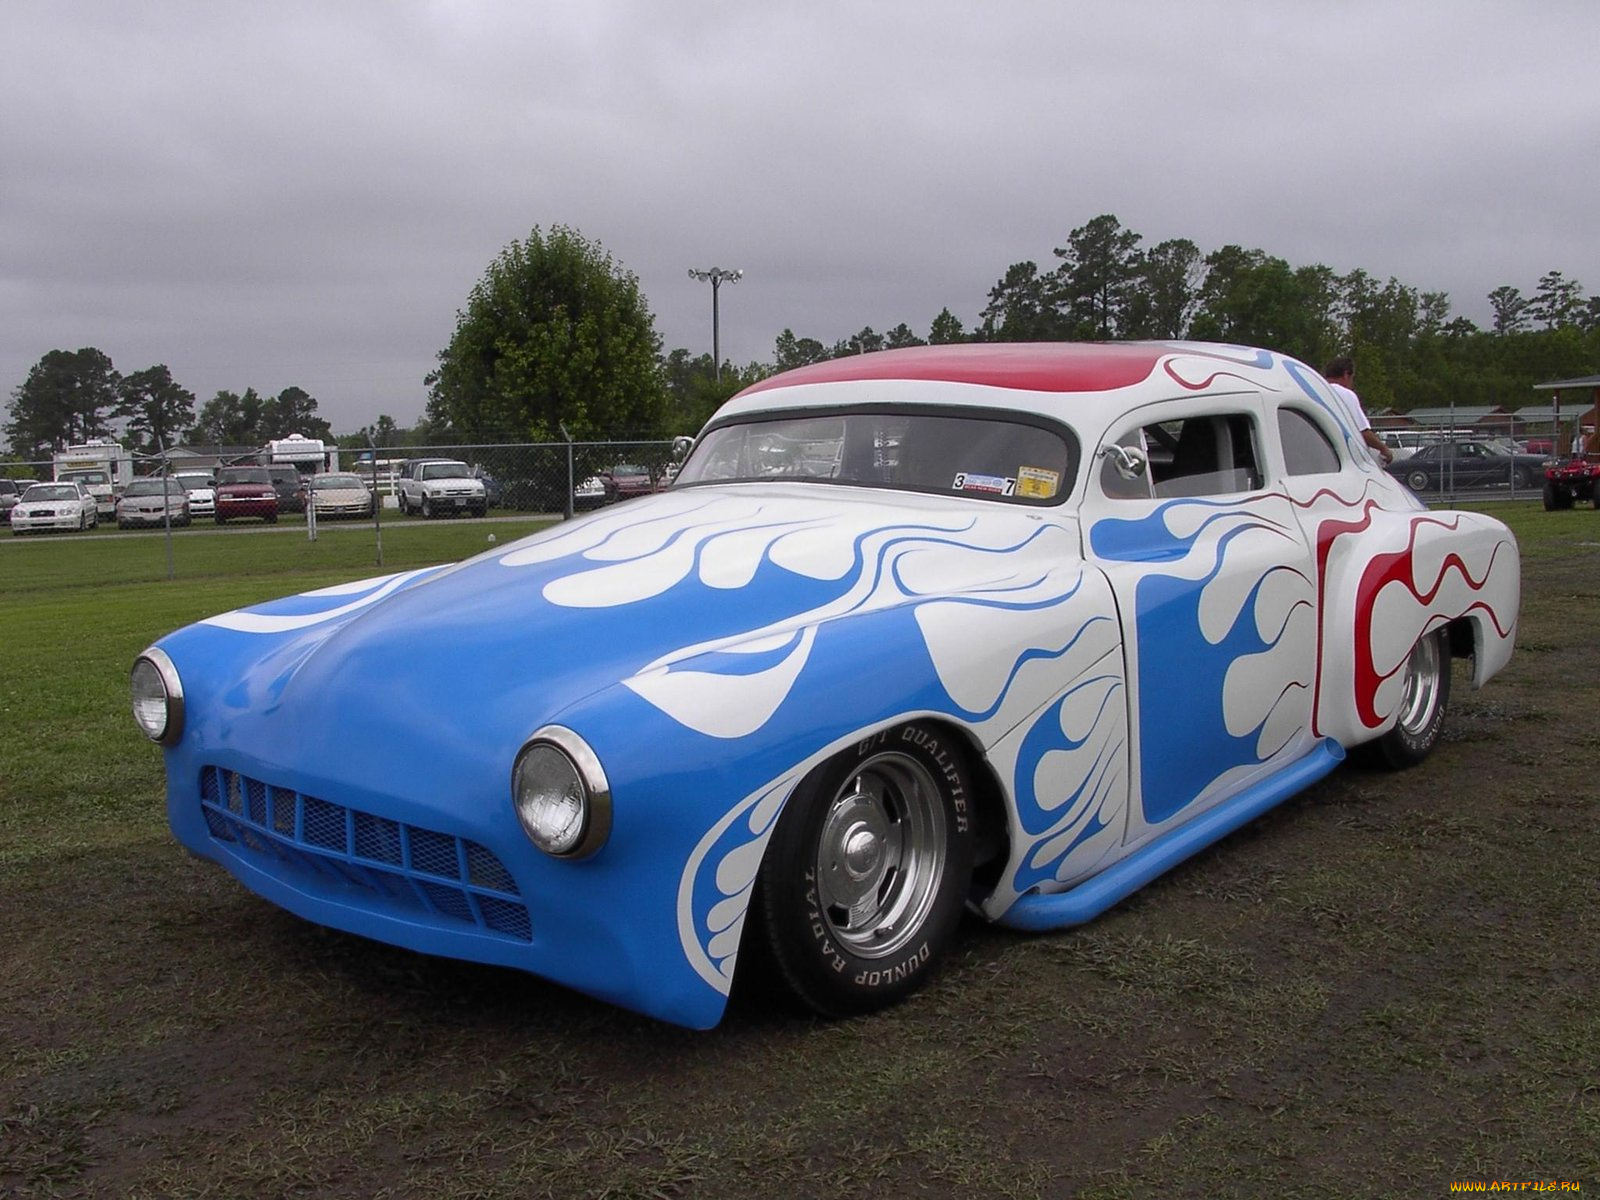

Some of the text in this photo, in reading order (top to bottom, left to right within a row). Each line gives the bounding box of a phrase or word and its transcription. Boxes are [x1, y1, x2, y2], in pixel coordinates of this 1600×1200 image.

[954, 474, 965, 488] 3
[1006, 479, 1016, 494] 7
[902, 726, 968, 833] QUALIFIER
[806, 866, 931, 986] DUNLOP RADIAL
